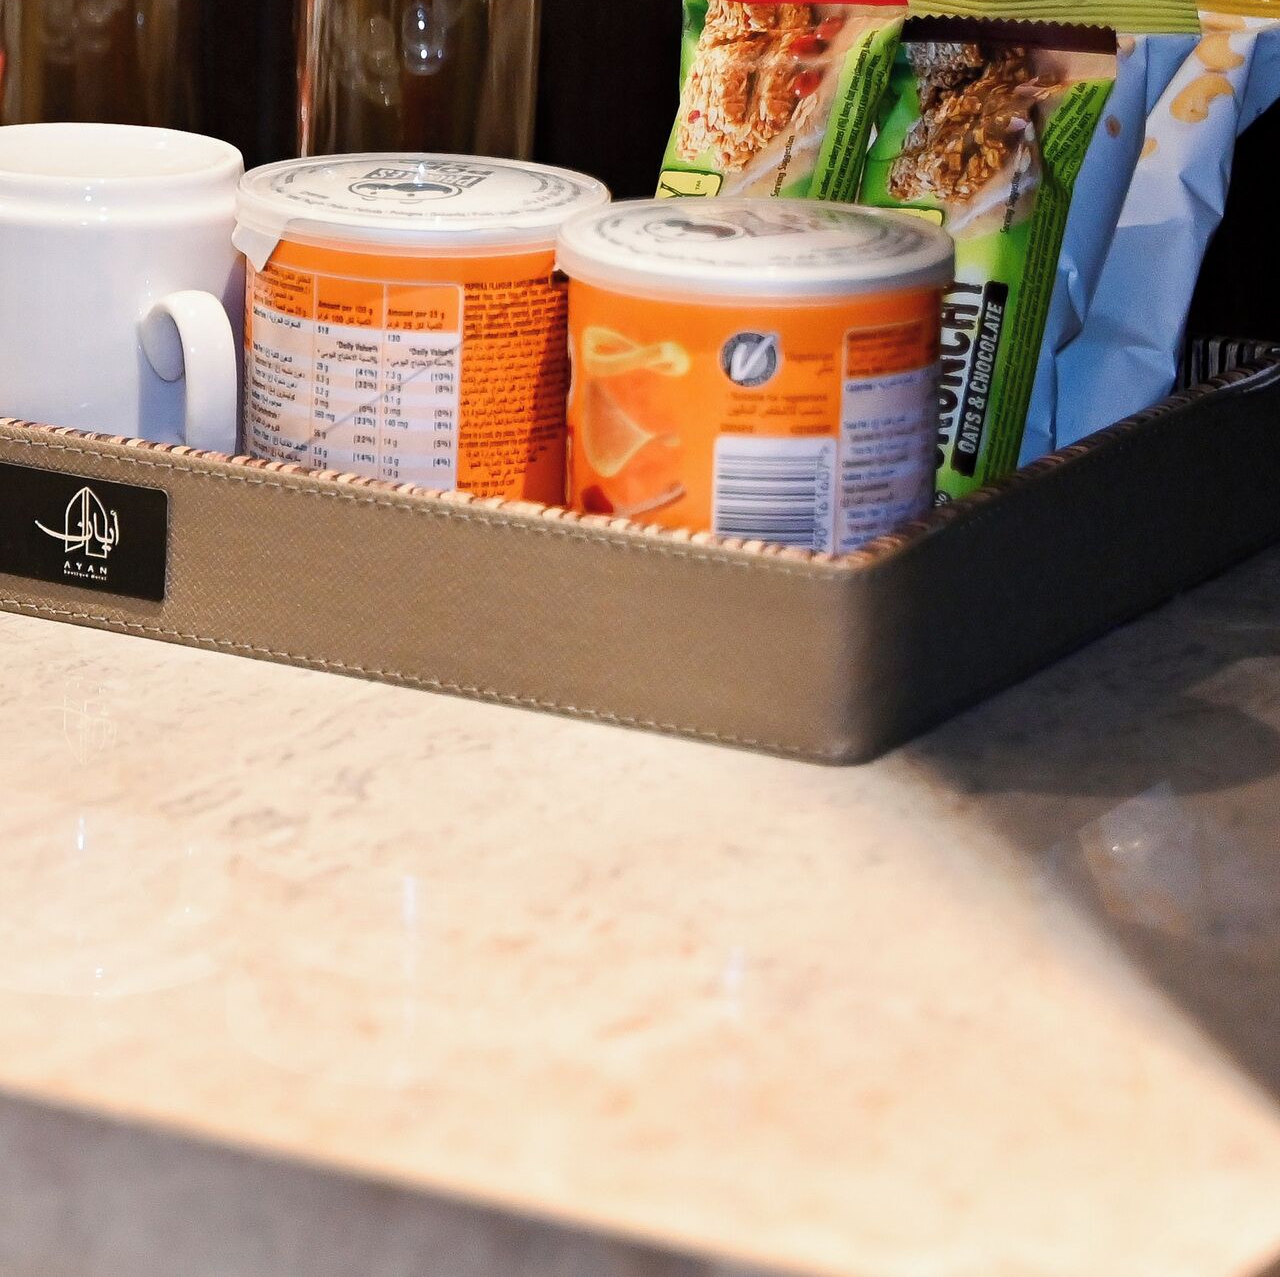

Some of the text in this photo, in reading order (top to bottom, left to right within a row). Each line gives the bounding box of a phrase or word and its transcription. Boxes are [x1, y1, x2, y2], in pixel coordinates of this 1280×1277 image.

[770, 135, 796, 197] Serving Suggestion
[957, 301, 1003, 454] OATS & CHOCOLATE
[63, 560, 107, 575] AYAN
